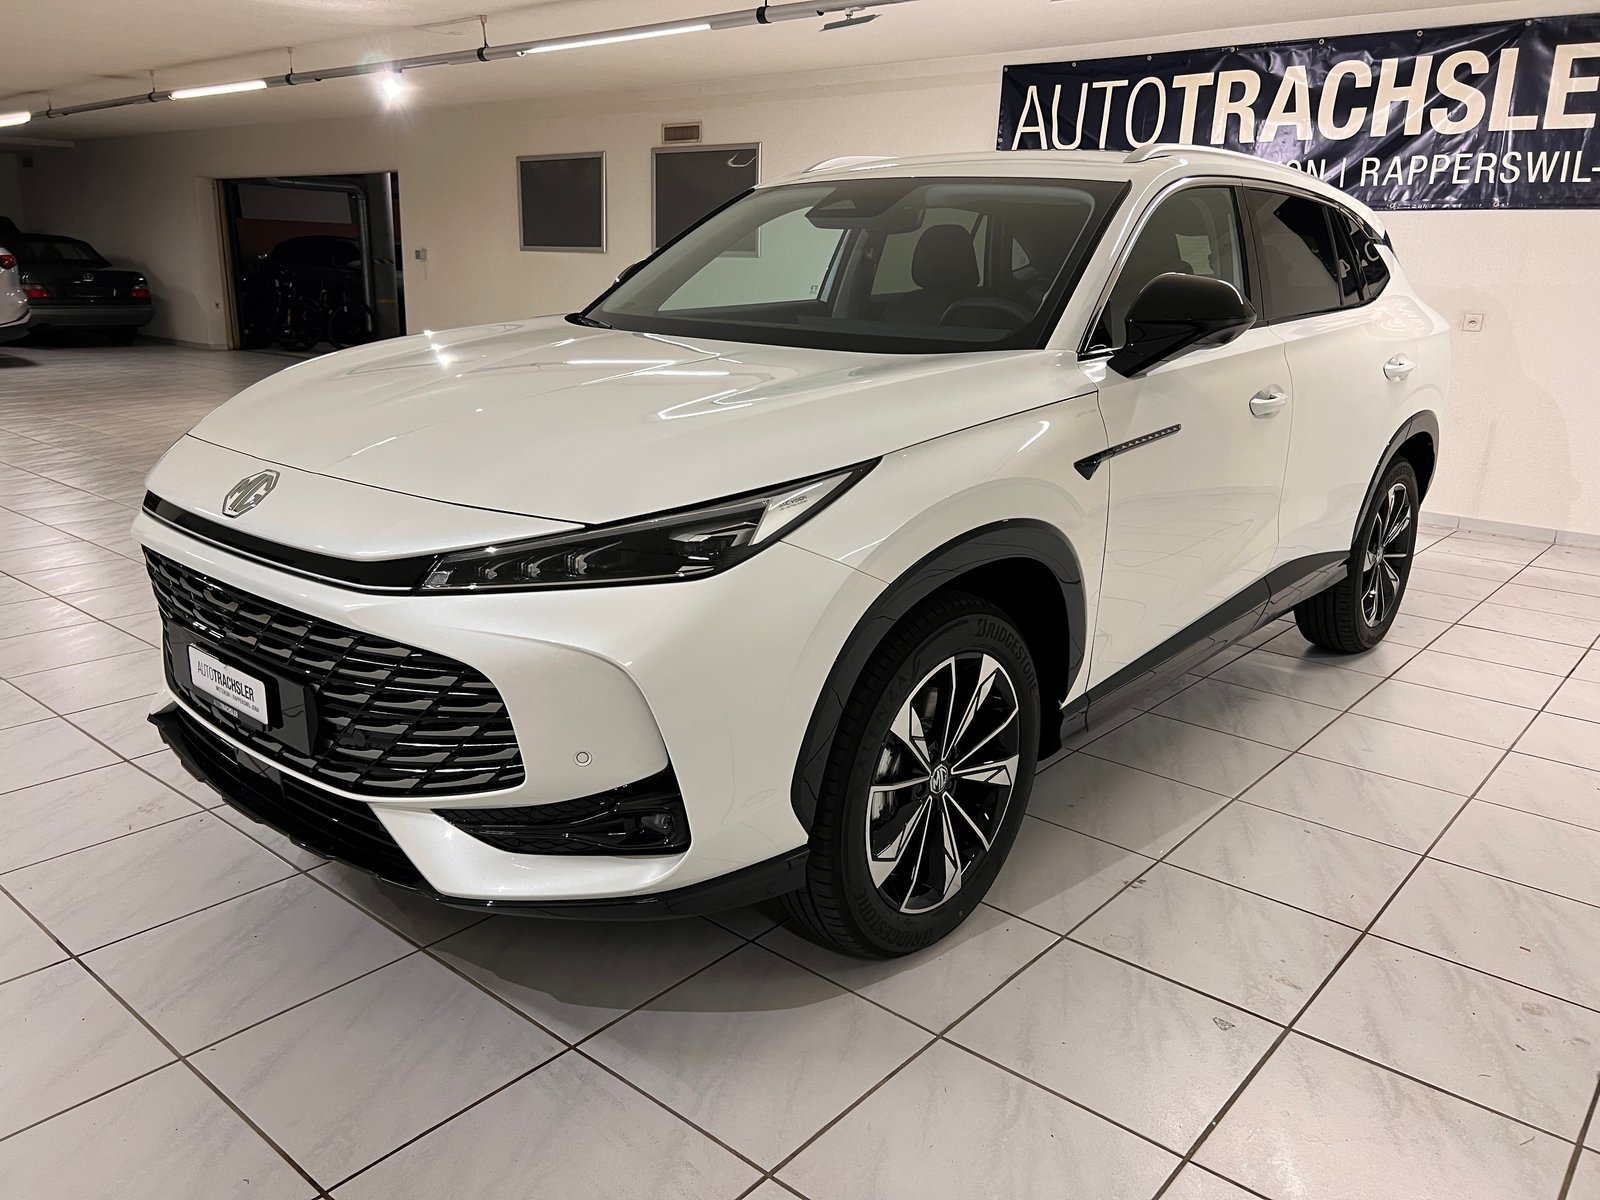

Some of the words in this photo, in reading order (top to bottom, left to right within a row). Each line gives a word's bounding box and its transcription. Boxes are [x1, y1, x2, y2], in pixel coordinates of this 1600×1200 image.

[227, 471, 276, 513] MG
[974, 618, 1038, 696] BRIDGESTONE
[197, 660, 255, 703] AUTOTRACHSLER
